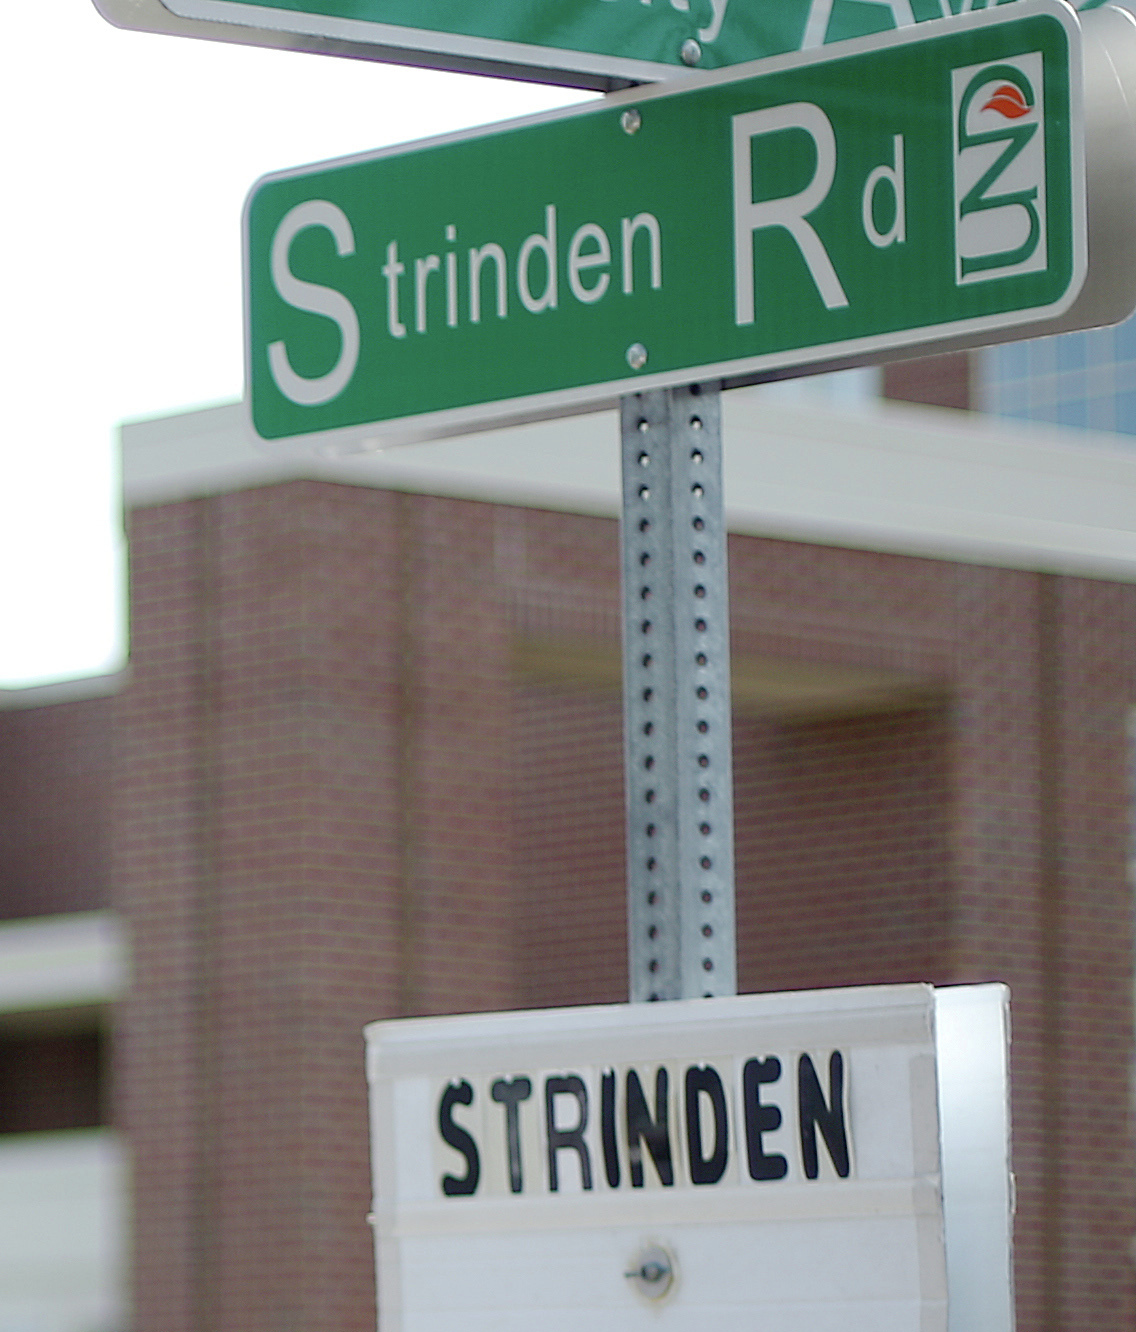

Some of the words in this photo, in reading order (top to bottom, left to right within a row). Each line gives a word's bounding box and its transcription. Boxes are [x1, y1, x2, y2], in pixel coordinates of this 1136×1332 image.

[268, 199, 662, 406] Strinden
[731, 101, 906, 326] Rd
[958, 63, 1041, 280] UND
[437, 1049, 851, 1198] STRINDEN
